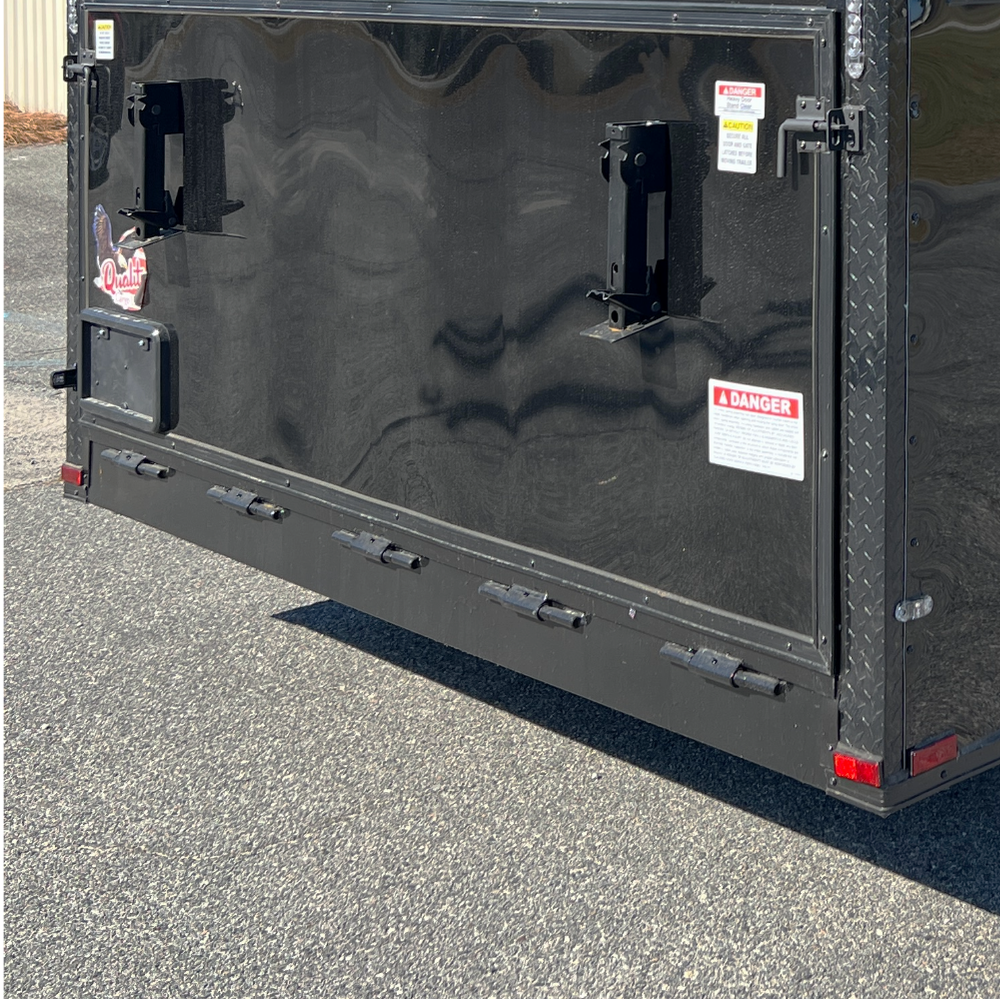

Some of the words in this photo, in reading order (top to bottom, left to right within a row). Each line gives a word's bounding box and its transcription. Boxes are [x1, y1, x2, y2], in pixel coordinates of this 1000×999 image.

[728, 87, 757, 96] DANGER
[728, 121, 754, 131] CAUTION
[101, 258, 143, 295] Qualit
[730, 391, 792, 416] DANGER
